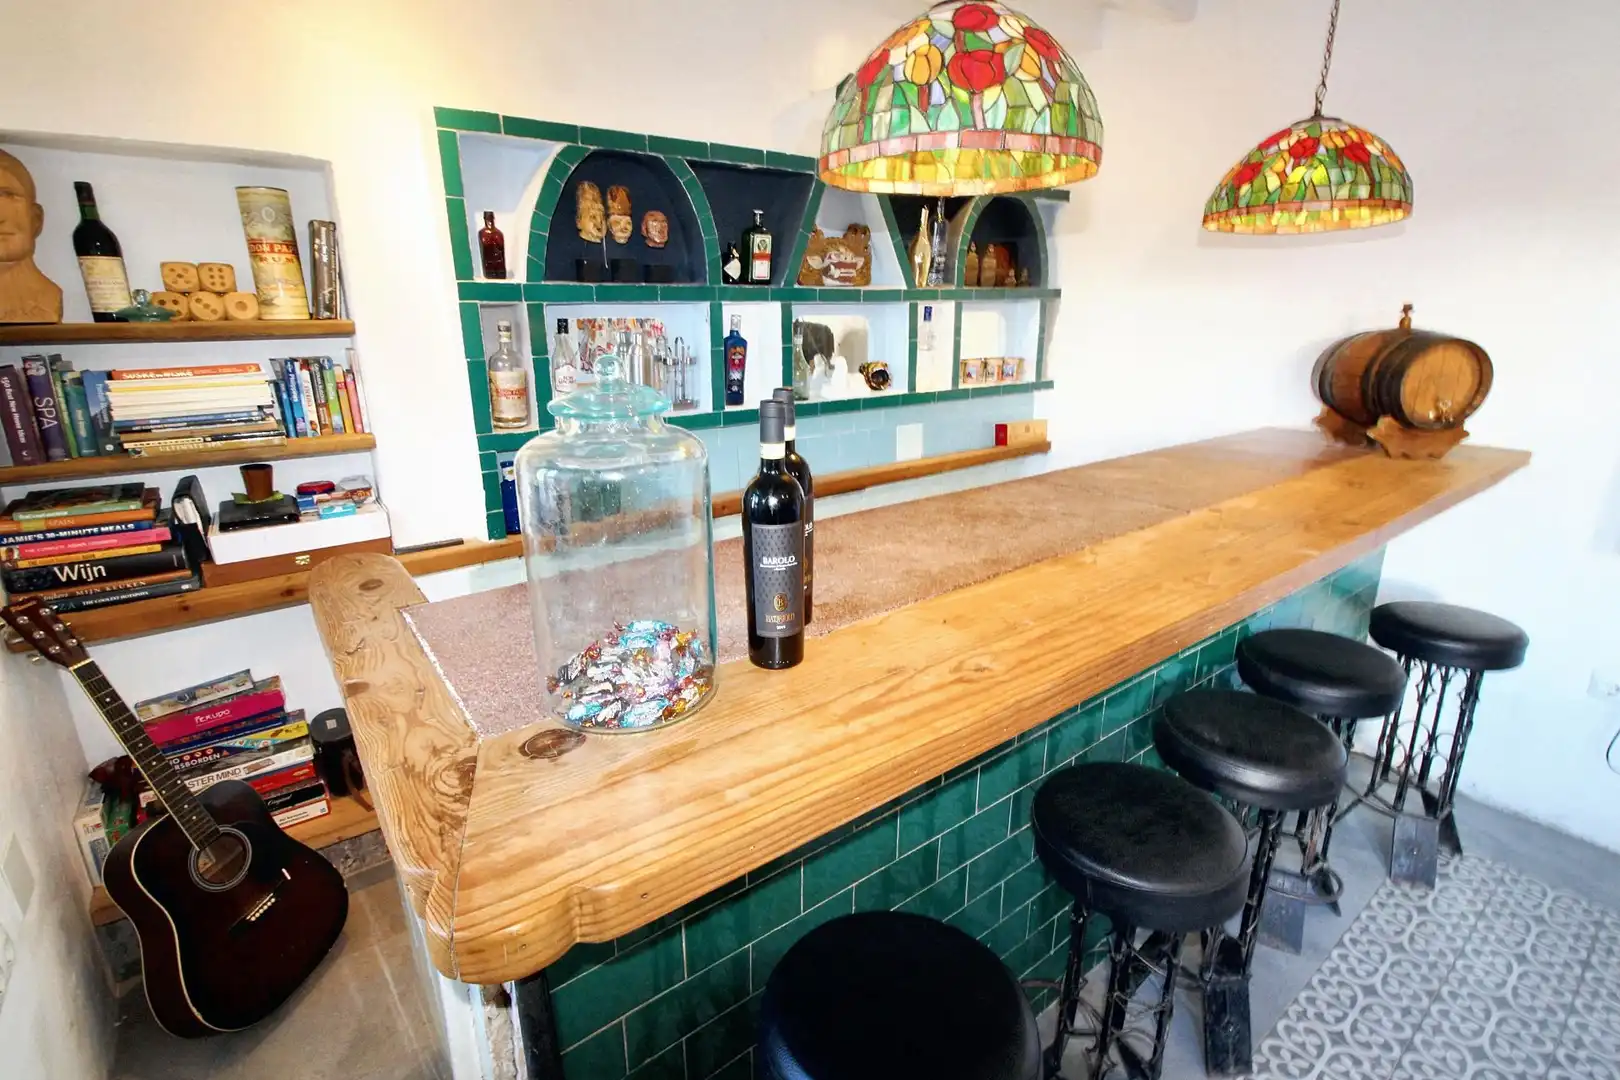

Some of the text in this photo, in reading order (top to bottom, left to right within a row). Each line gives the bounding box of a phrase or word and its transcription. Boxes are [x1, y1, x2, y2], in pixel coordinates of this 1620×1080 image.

[34, 396, 58, 430] SPA
[1, 533, 45, 545] JAMIE'S
[100, 523, 135, 533] MEALS
[762, 555, 796, 565] BAROLO
[54, 562, 107, 582] Wijn
[75, 587, 101, 597] MIJN
[105, 580, 147, 592] KEUKEN
[187, 767, 242, 790] STER MIND
